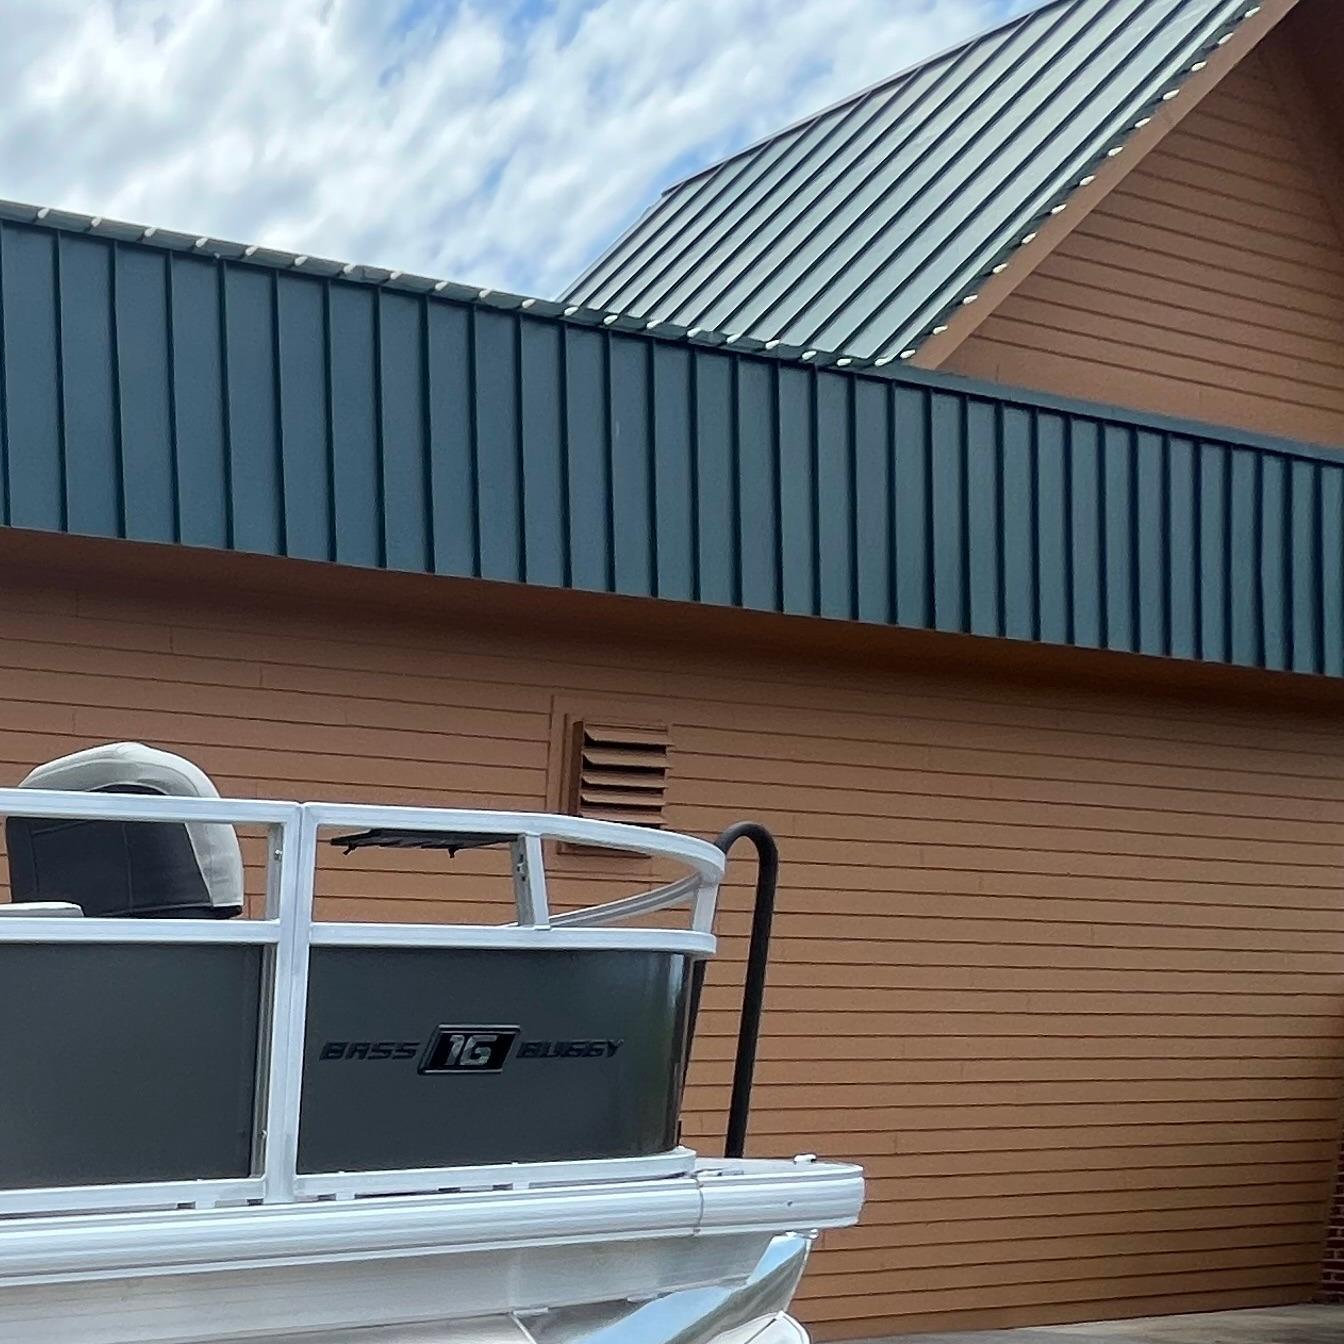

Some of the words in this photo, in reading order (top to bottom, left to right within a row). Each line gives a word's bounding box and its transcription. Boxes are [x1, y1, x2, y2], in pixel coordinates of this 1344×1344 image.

[319, 1041, 420, 1062] BASS
[444, 1034, 498, 1066] 16
[516, 1039, 624, 1059] BUGGY
